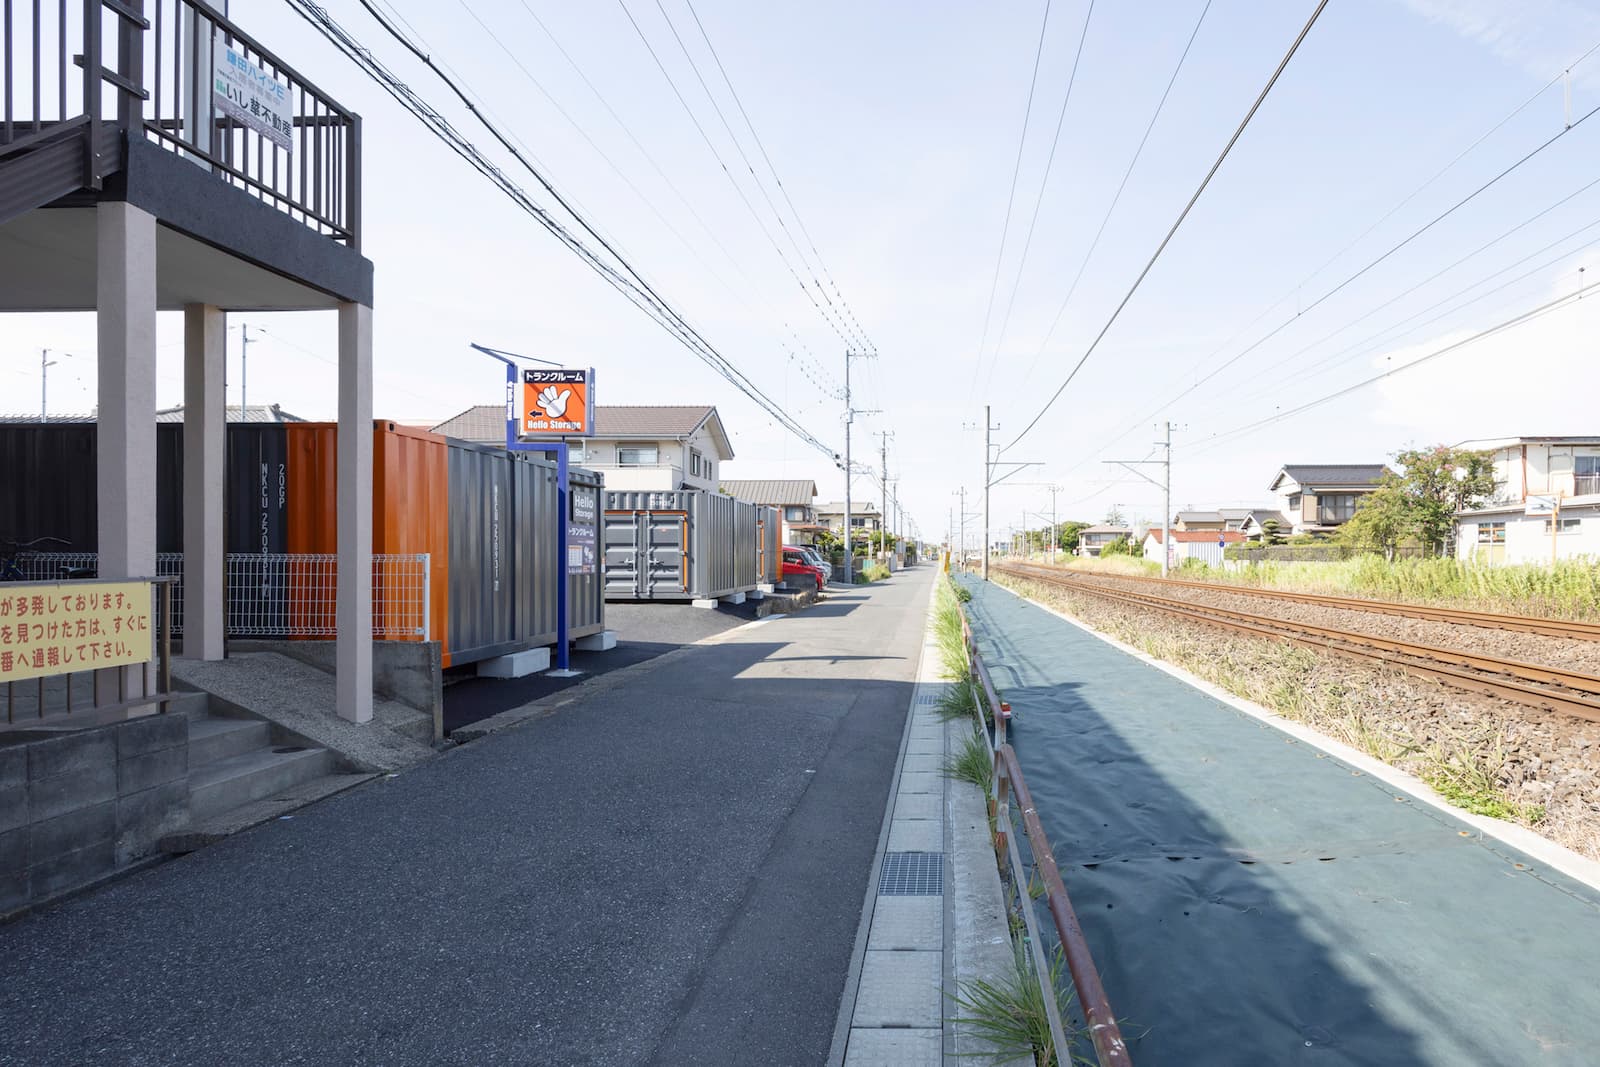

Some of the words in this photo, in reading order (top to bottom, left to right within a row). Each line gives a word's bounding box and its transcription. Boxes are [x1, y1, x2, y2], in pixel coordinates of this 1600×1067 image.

[526, 372, 584, 382] トランクルーム
[527, 420, 549, 429] Hello
[550, 420, 582, 430] Storage
[574, 495, 594, 509] Hello
[575, 508, 594, 519] Storage
[0, 591, 132, 617] が多発しております。
[0, 615, 147, 645] を見つけた方は、すぐに
[0, 641, 133, 673] 番へ通報して下さい。
